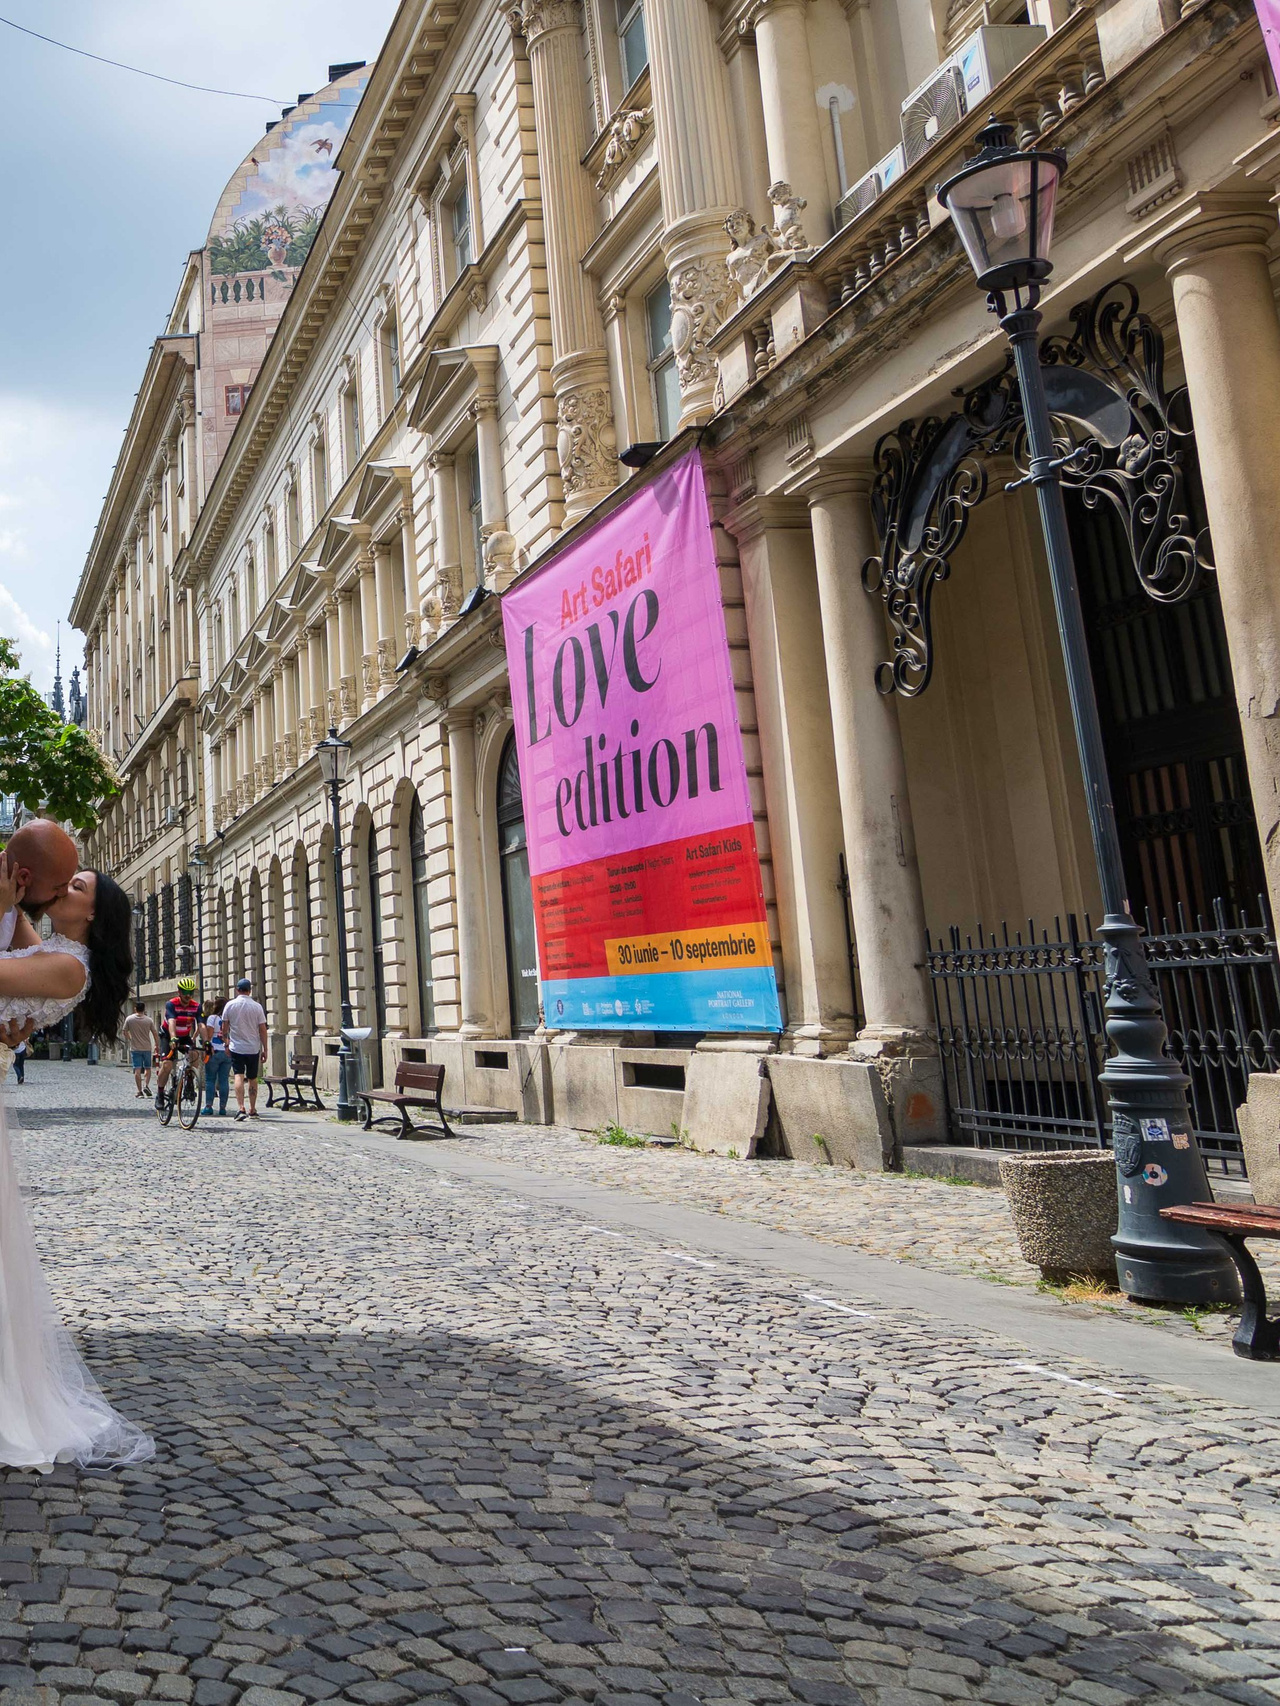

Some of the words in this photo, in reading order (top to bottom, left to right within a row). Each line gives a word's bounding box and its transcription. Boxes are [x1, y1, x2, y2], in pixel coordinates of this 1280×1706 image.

[561, 588, 589, 630] Art
[591, 531, 652, 608] Safari
[521, 589, 662, 748] Love
[556, 719, 724, 837] edition
[686, 847, 699, 861] Art
[698, 842, 723, 859] Safari
[722, 837, 742, 854] Kids
[618, 944, 632, 965] 30
[632, 942, 659, 964] iunie
[670, 938, 683, 960] 10
[685, 932, 756, 963] septembrie
[708, 999, 732, 1008] PORTRAIT
[732, 999, 755, 1008] GALLERY
[716, 990, 743, 999] NATIONAL
